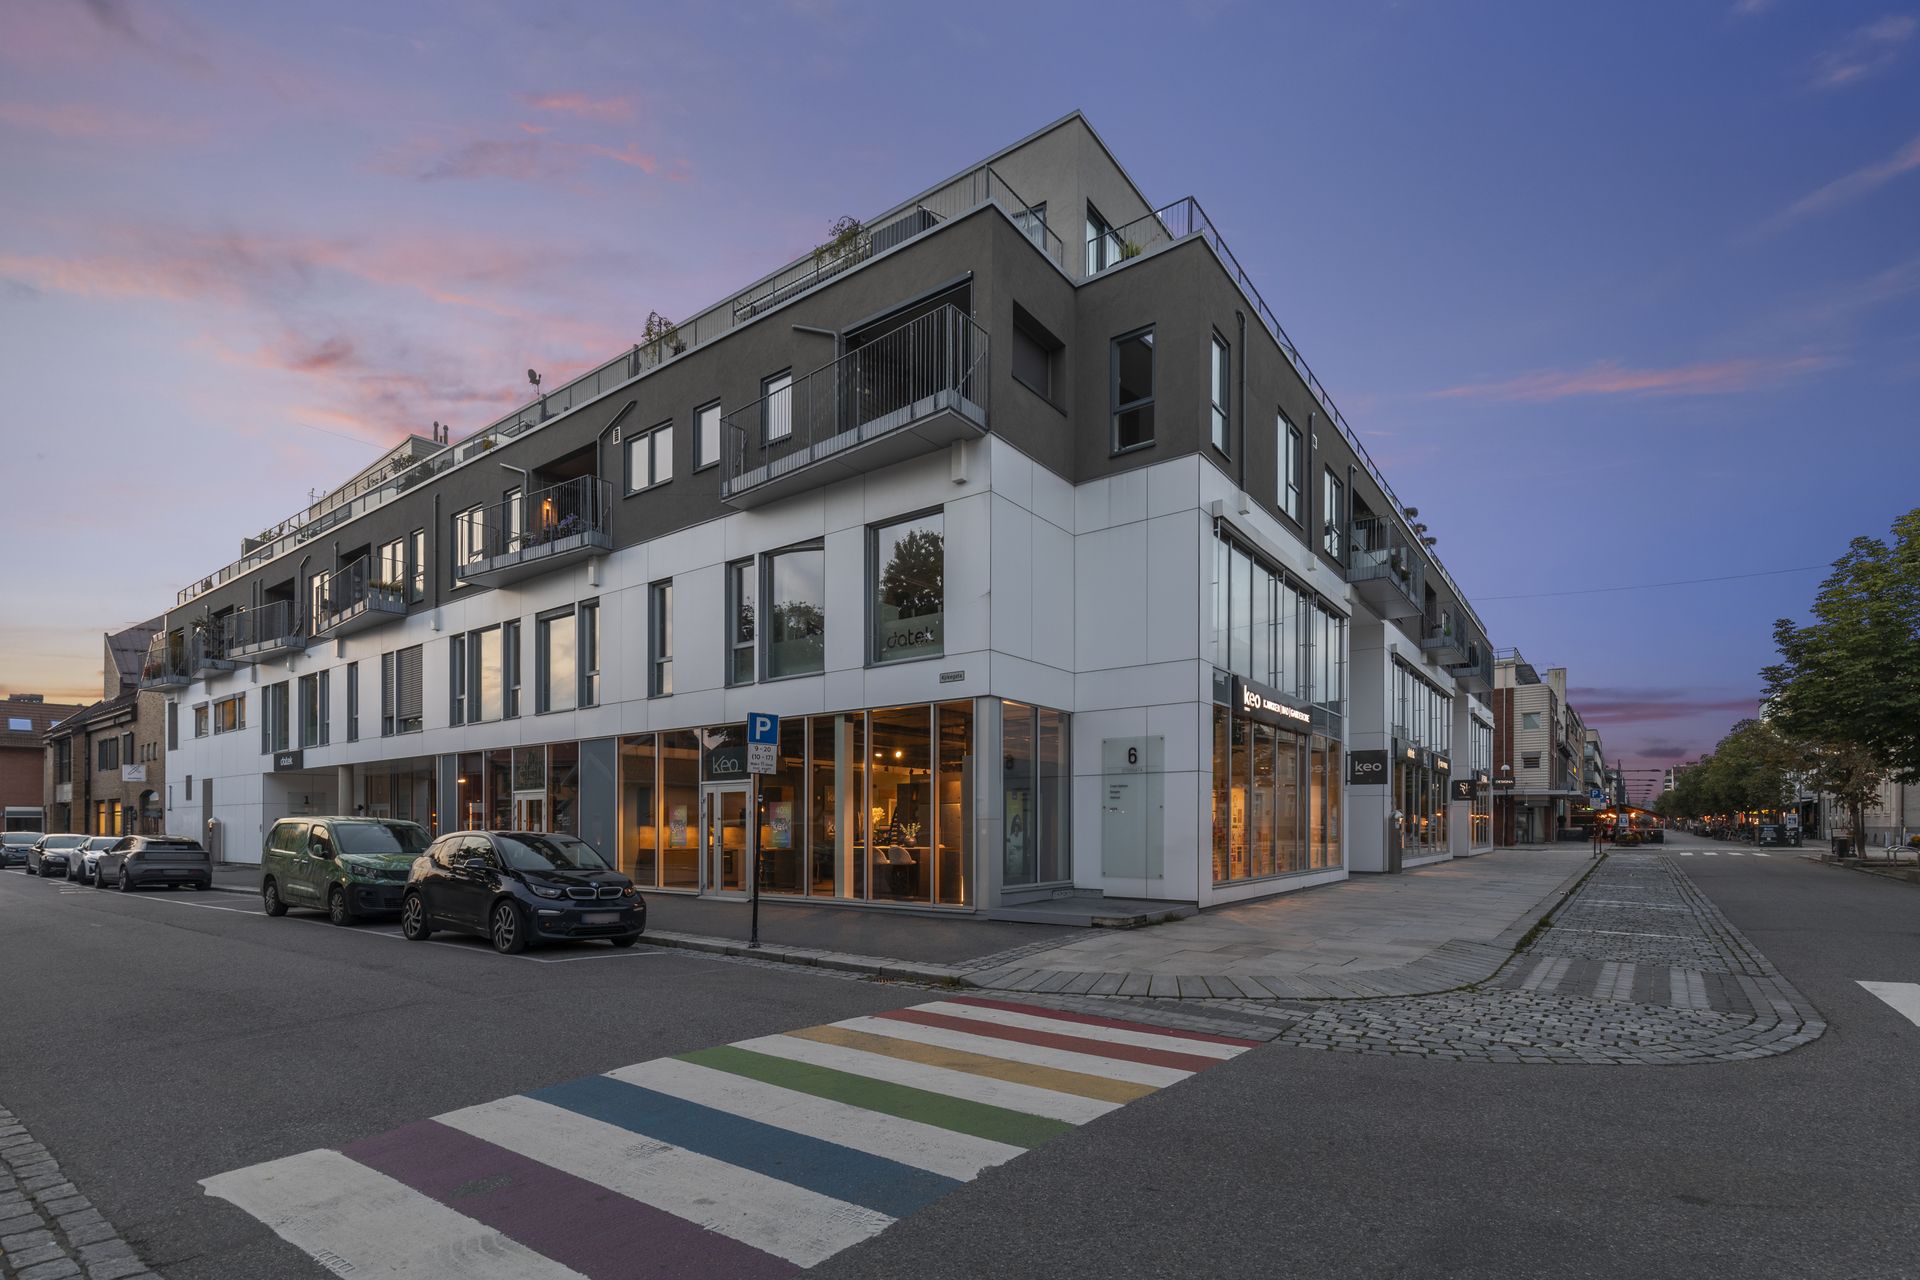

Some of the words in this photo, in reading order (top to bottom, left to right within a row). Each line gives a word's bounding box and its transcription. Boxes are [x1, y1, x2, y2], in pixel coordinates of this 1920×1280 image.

[887, 626, 935, 649] datek
[1244, 685, 1261, 708] keo
[755, 716, 771, 740] P
[713, 755, 739, 773] keo
[1128, 747, 1137, 764] 6
[1354, 760, 1382, 772] keo
